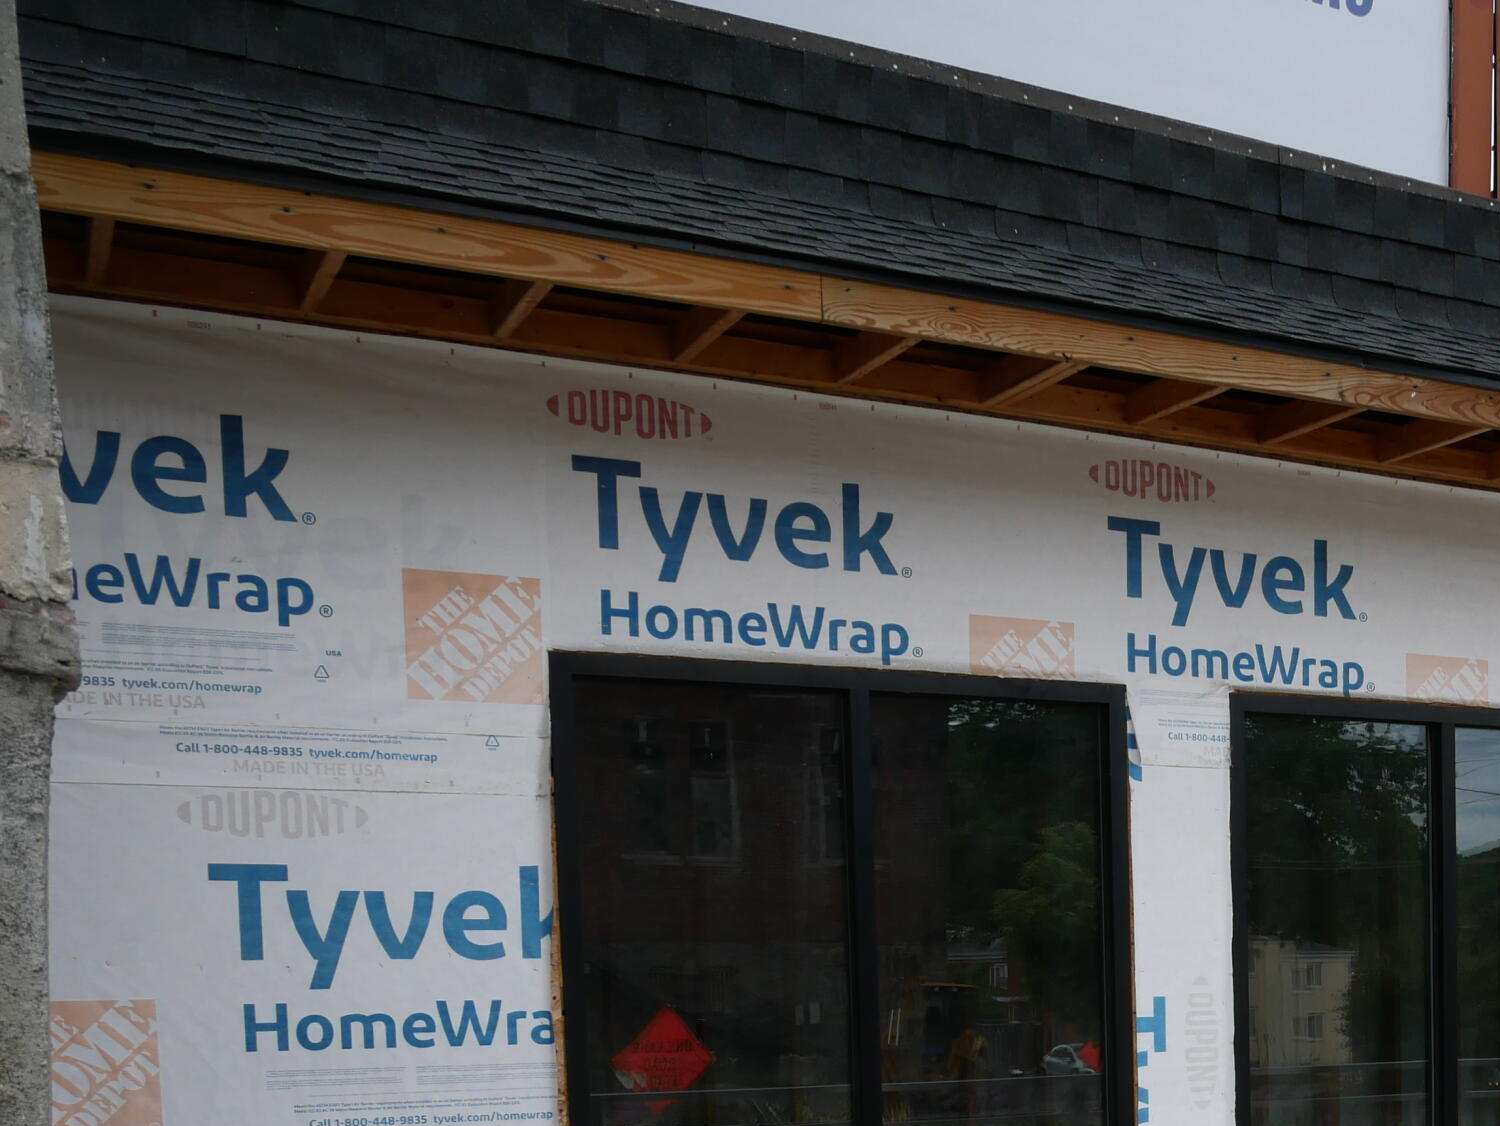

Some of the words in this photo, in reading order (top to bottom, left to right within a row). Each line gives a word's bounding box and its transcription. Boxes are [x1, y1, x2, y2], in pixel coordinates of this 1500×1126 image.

[568, 389, 696, 440] DUPONT
[1104, 459, 1202, 503] DUPONT
[416, 585, 475, 636] THE
[407, 576, 541, 700] HOME
[462, 625, 543, 702] DEPOT
[121, 678, 262, 696] tyvek.com/homewrap
[126, 693, 164, 708] THE
[169, 694, 206, 709] USA
[176, 742, 200, 753] Call
[202, 743, 303, 757] 1-800-448-9835
[309, 748, 438, 763] tyvek.com/homewrap
[1168, 732, 1183, 741] Call
[1185, 733, 1230, 743] 1-800-448-
[233, 759, 286, 775] MADE
[291, 761, 308, 775] IN
[313, 762, 347, 777] THE
[352, 763, 385, 778] USA
[200, 790, 349, 839] DUPONT
[244, 1000, 556, 1052] HomeWra
[433, 1111, 553, 1125] tyvek.com/homewrap
